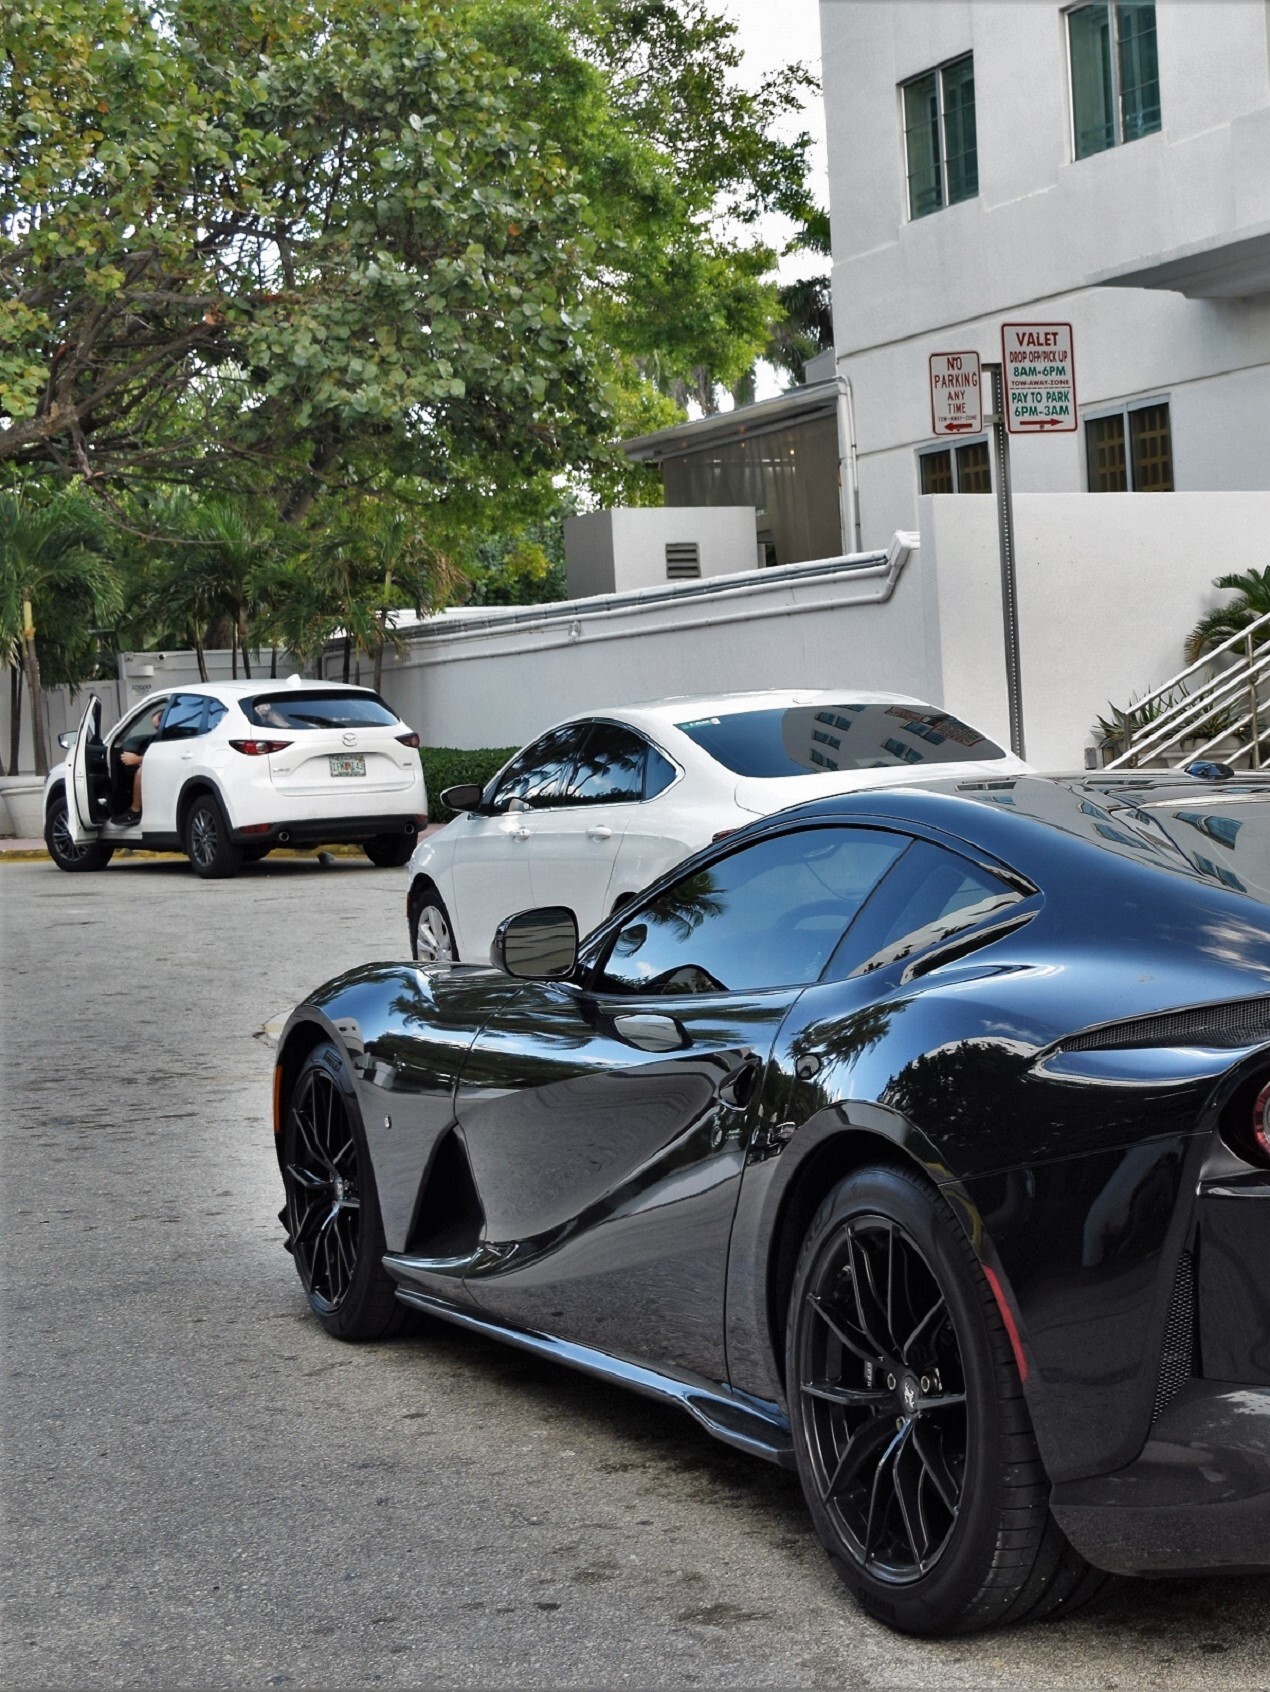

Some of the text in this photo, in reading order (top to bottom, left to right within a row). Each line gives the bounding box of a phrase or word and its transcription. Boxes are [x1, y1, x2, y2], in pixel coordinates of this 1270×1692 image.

[1015, 332, 1059, 347] VALET
[1009, 350, 1028, 363] DROP
[1058, 350, 1068, 363] UP
[946, 356, 963, 371] NO
[1013, 365, 1067, 377] 8AM-6PM
[933, 372, 978, 389] PARKING
[947, 390, 966, 402] ANY
[1011, 390, 1070, 404] PAY TO PARK
[947, 402, 967, 415] TIME
[1014, 404, 1070, 417] 6PM-3AM
